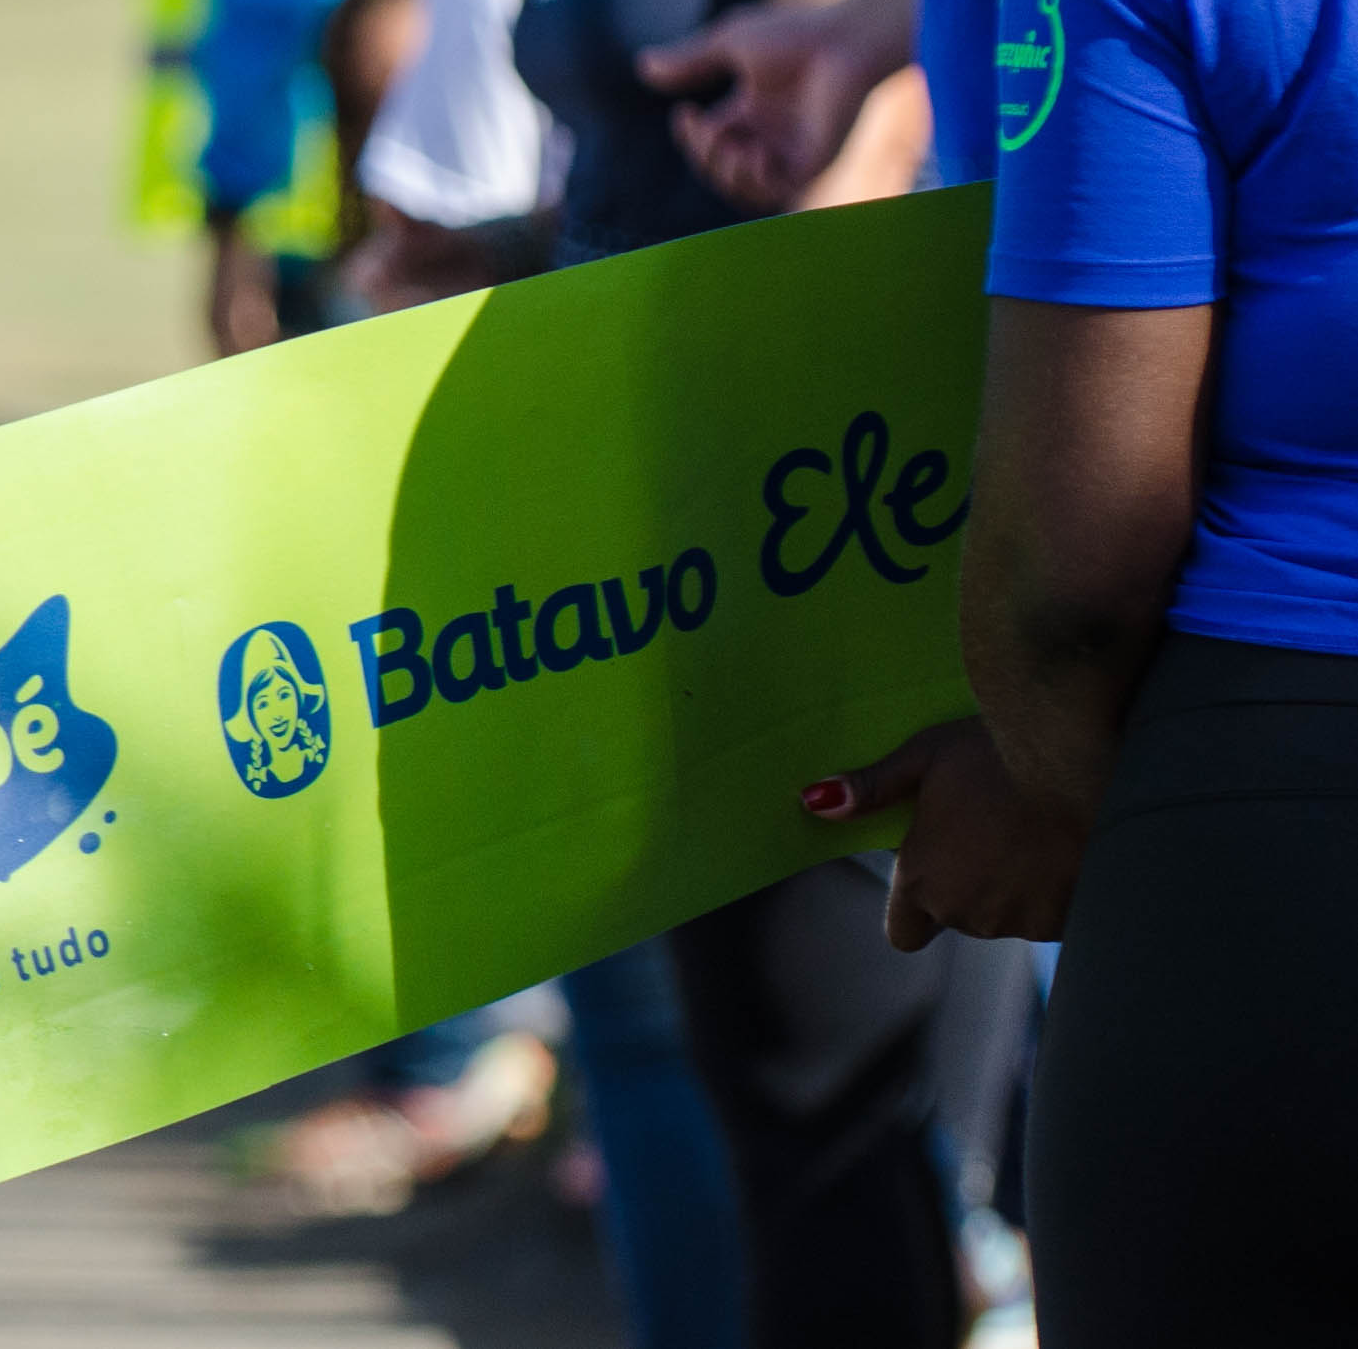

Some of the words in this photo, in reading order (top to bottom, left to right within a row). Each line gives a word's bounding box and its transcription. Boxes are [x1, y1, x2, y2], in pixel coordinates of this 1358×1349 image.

[759, 410, 972, 597] Ele
[349, 545, 718, 729] Batavo
[11, 922, 112, 985] tudo
